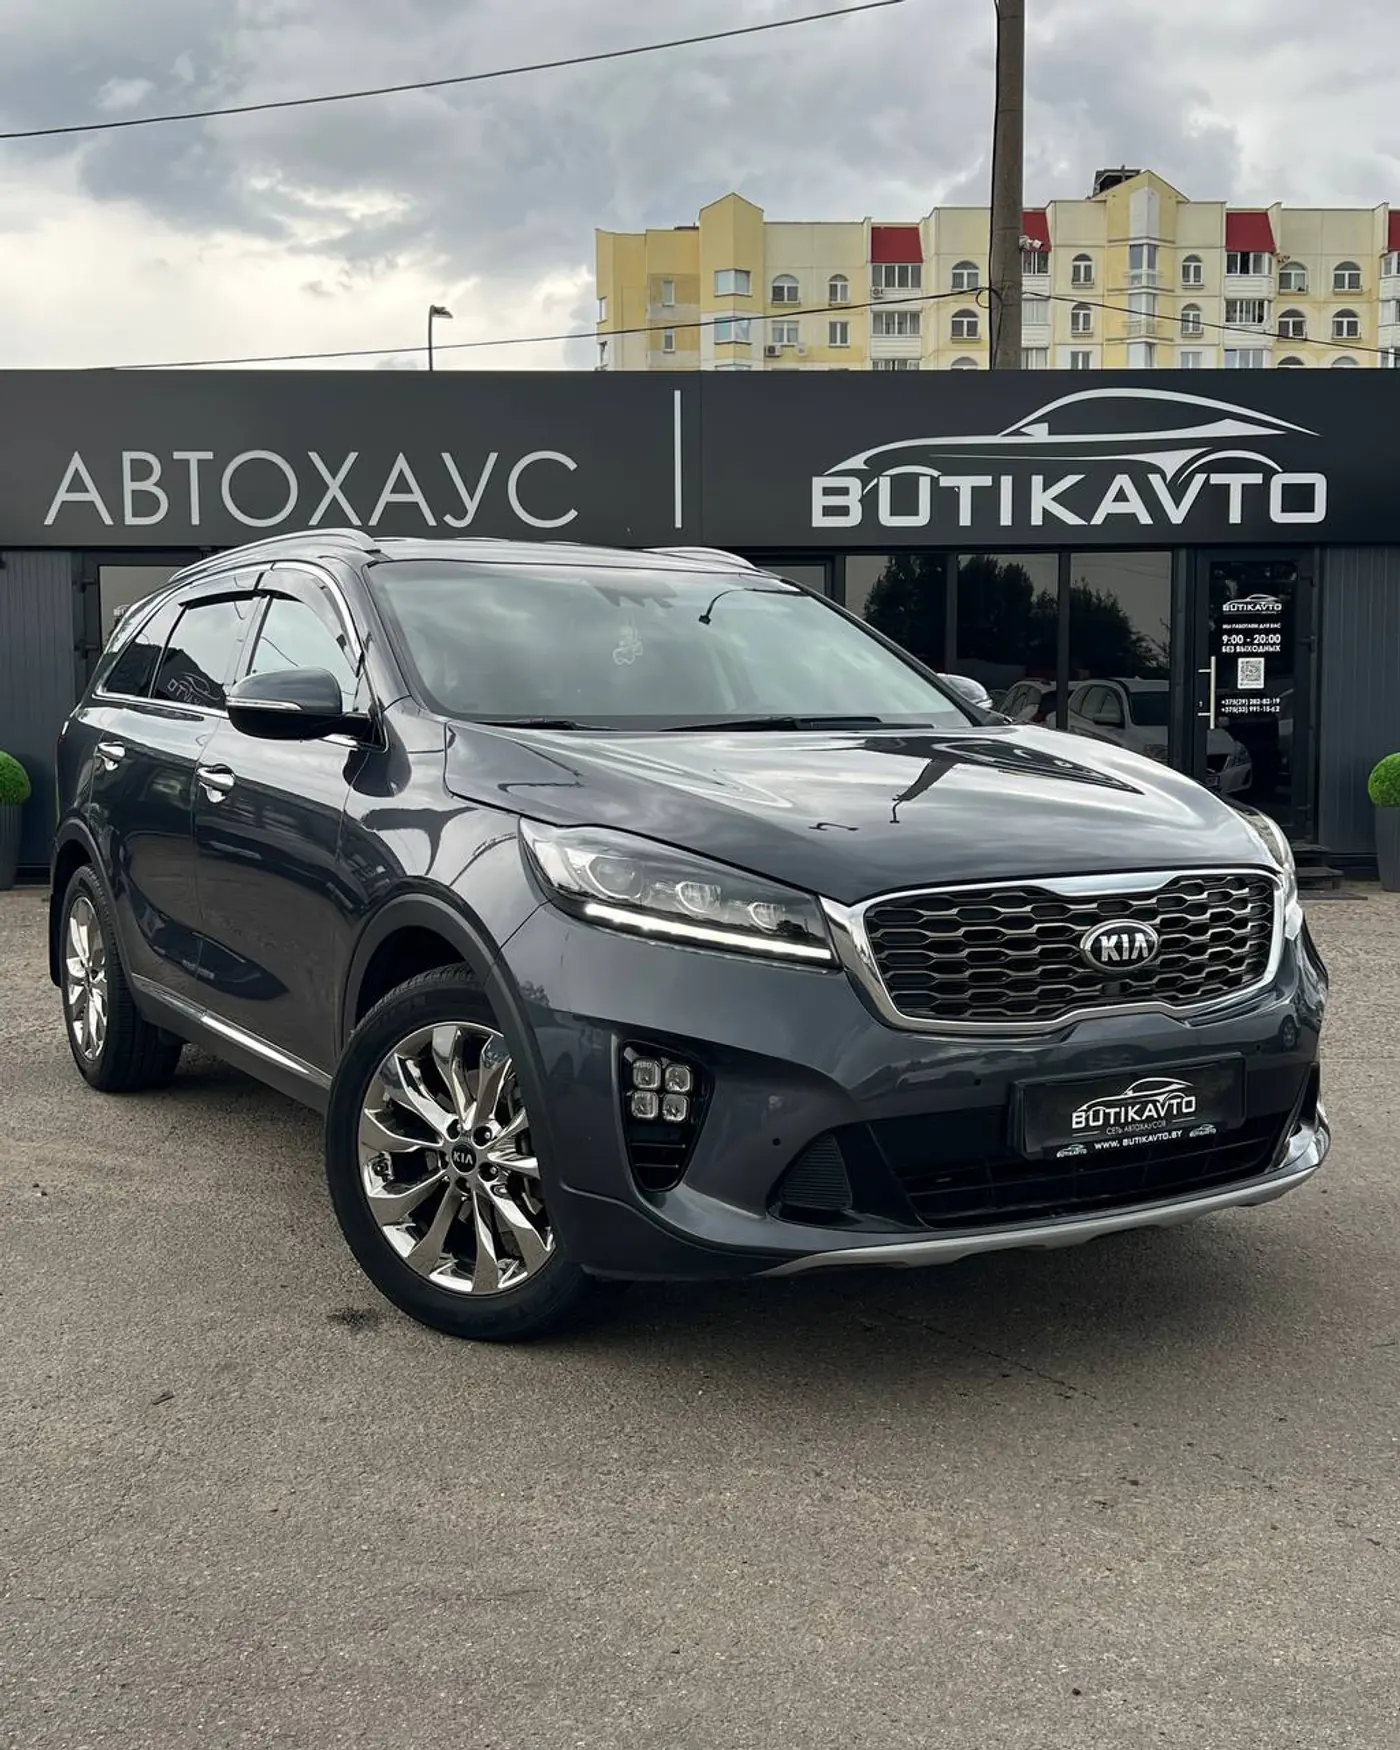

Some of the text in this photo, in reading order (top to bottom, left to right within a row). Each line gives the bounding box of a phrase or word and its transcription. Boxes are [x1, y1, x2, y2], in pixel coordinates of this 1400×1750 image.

[44, 450, 578, 528] АВТОХАУС
[811, 472, 1327, 527] BUTIKAVTO
[1222, 603, 1282, 612] BUTIKAVTO
[1222, 634, 1244, 644] 9:00
[1253, 633, 1281, 644] 20:00
[1236, 645, 1281, 653] ВЫХОДНЫХ
[1099, 932, 1149, 962] KIA
[1071, 1096, 1196, 1129] BUTIKAVTO
[453, 1151, 473, 1164] KIA
